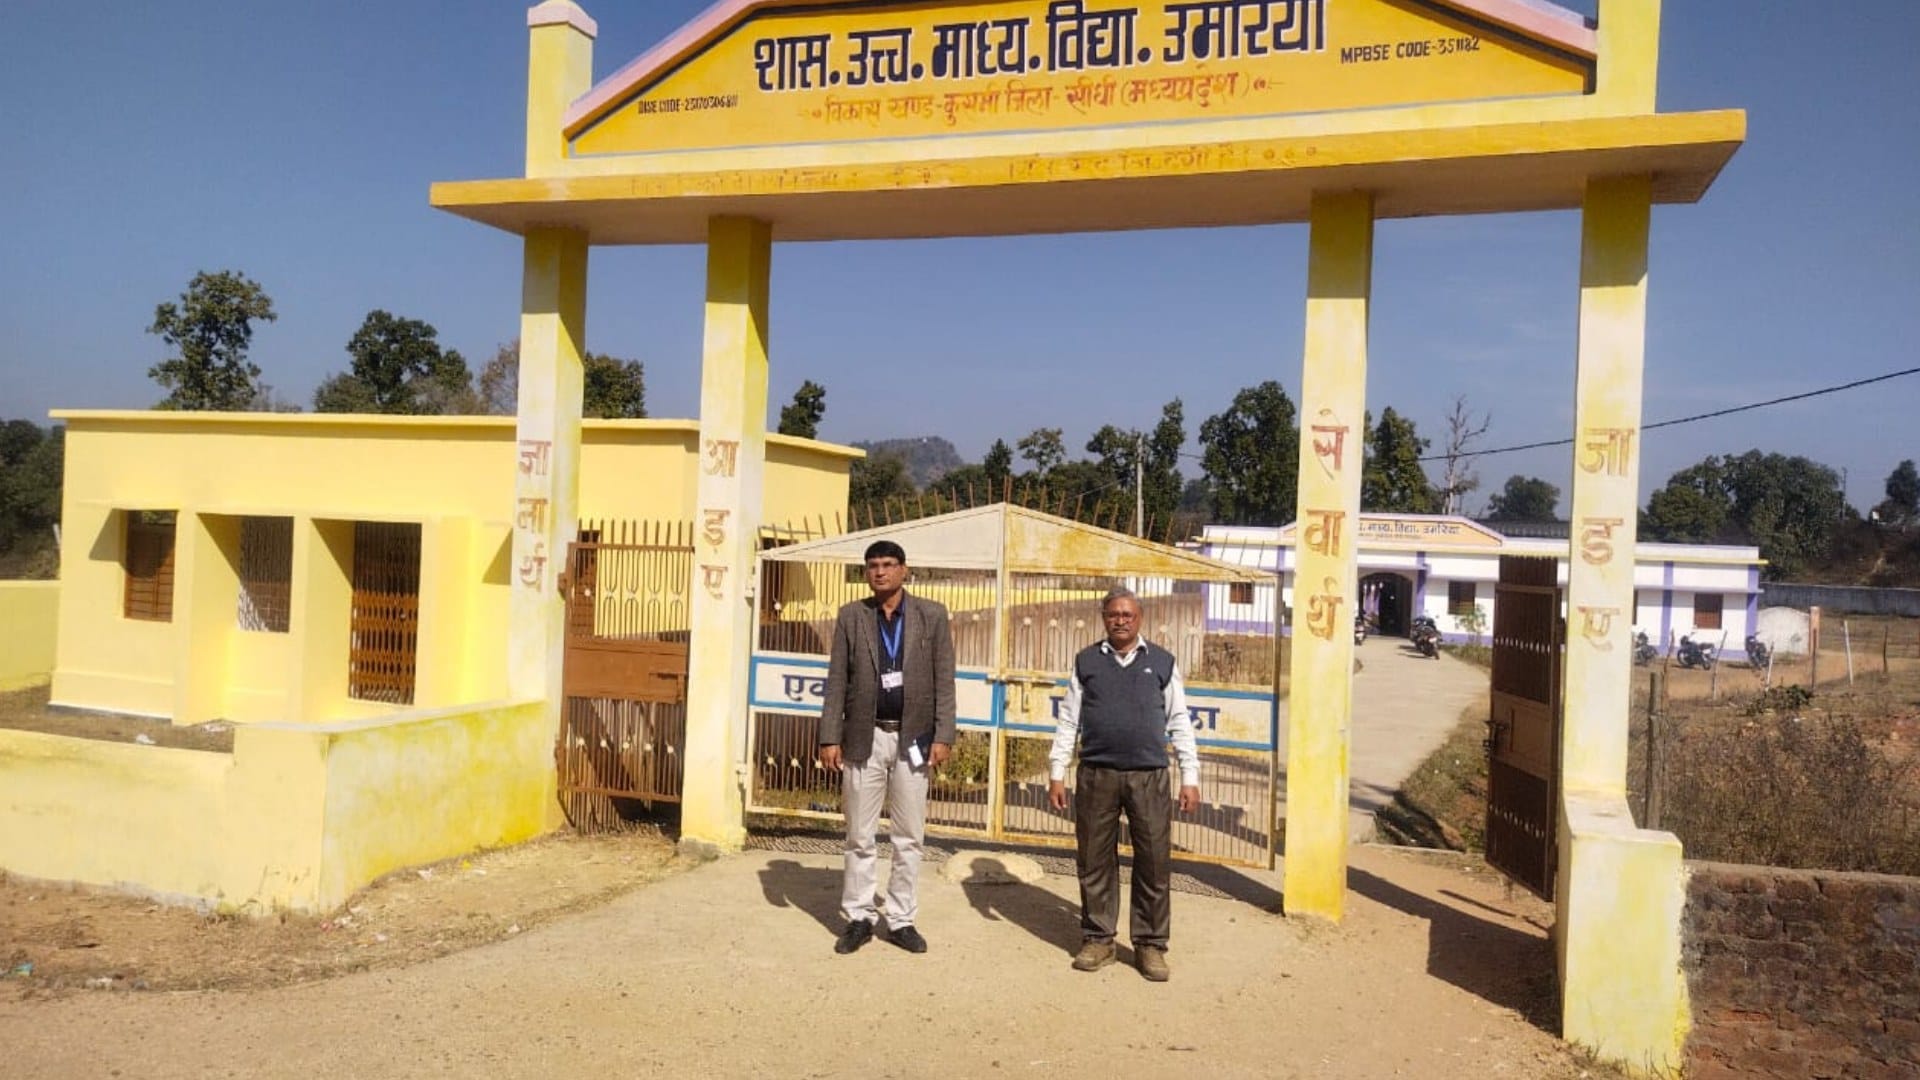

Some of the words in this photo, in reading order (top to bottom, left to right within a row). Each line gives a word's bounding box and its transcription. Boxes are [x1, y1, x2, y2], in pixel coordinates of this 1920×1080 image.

[754, 33, 840, 91] शास.
[932, 17, 1040, 79] माध्य.
[1046, 0, 1152, 71] विद्या.
[1341, 44, 1391, 64] MPBSE
